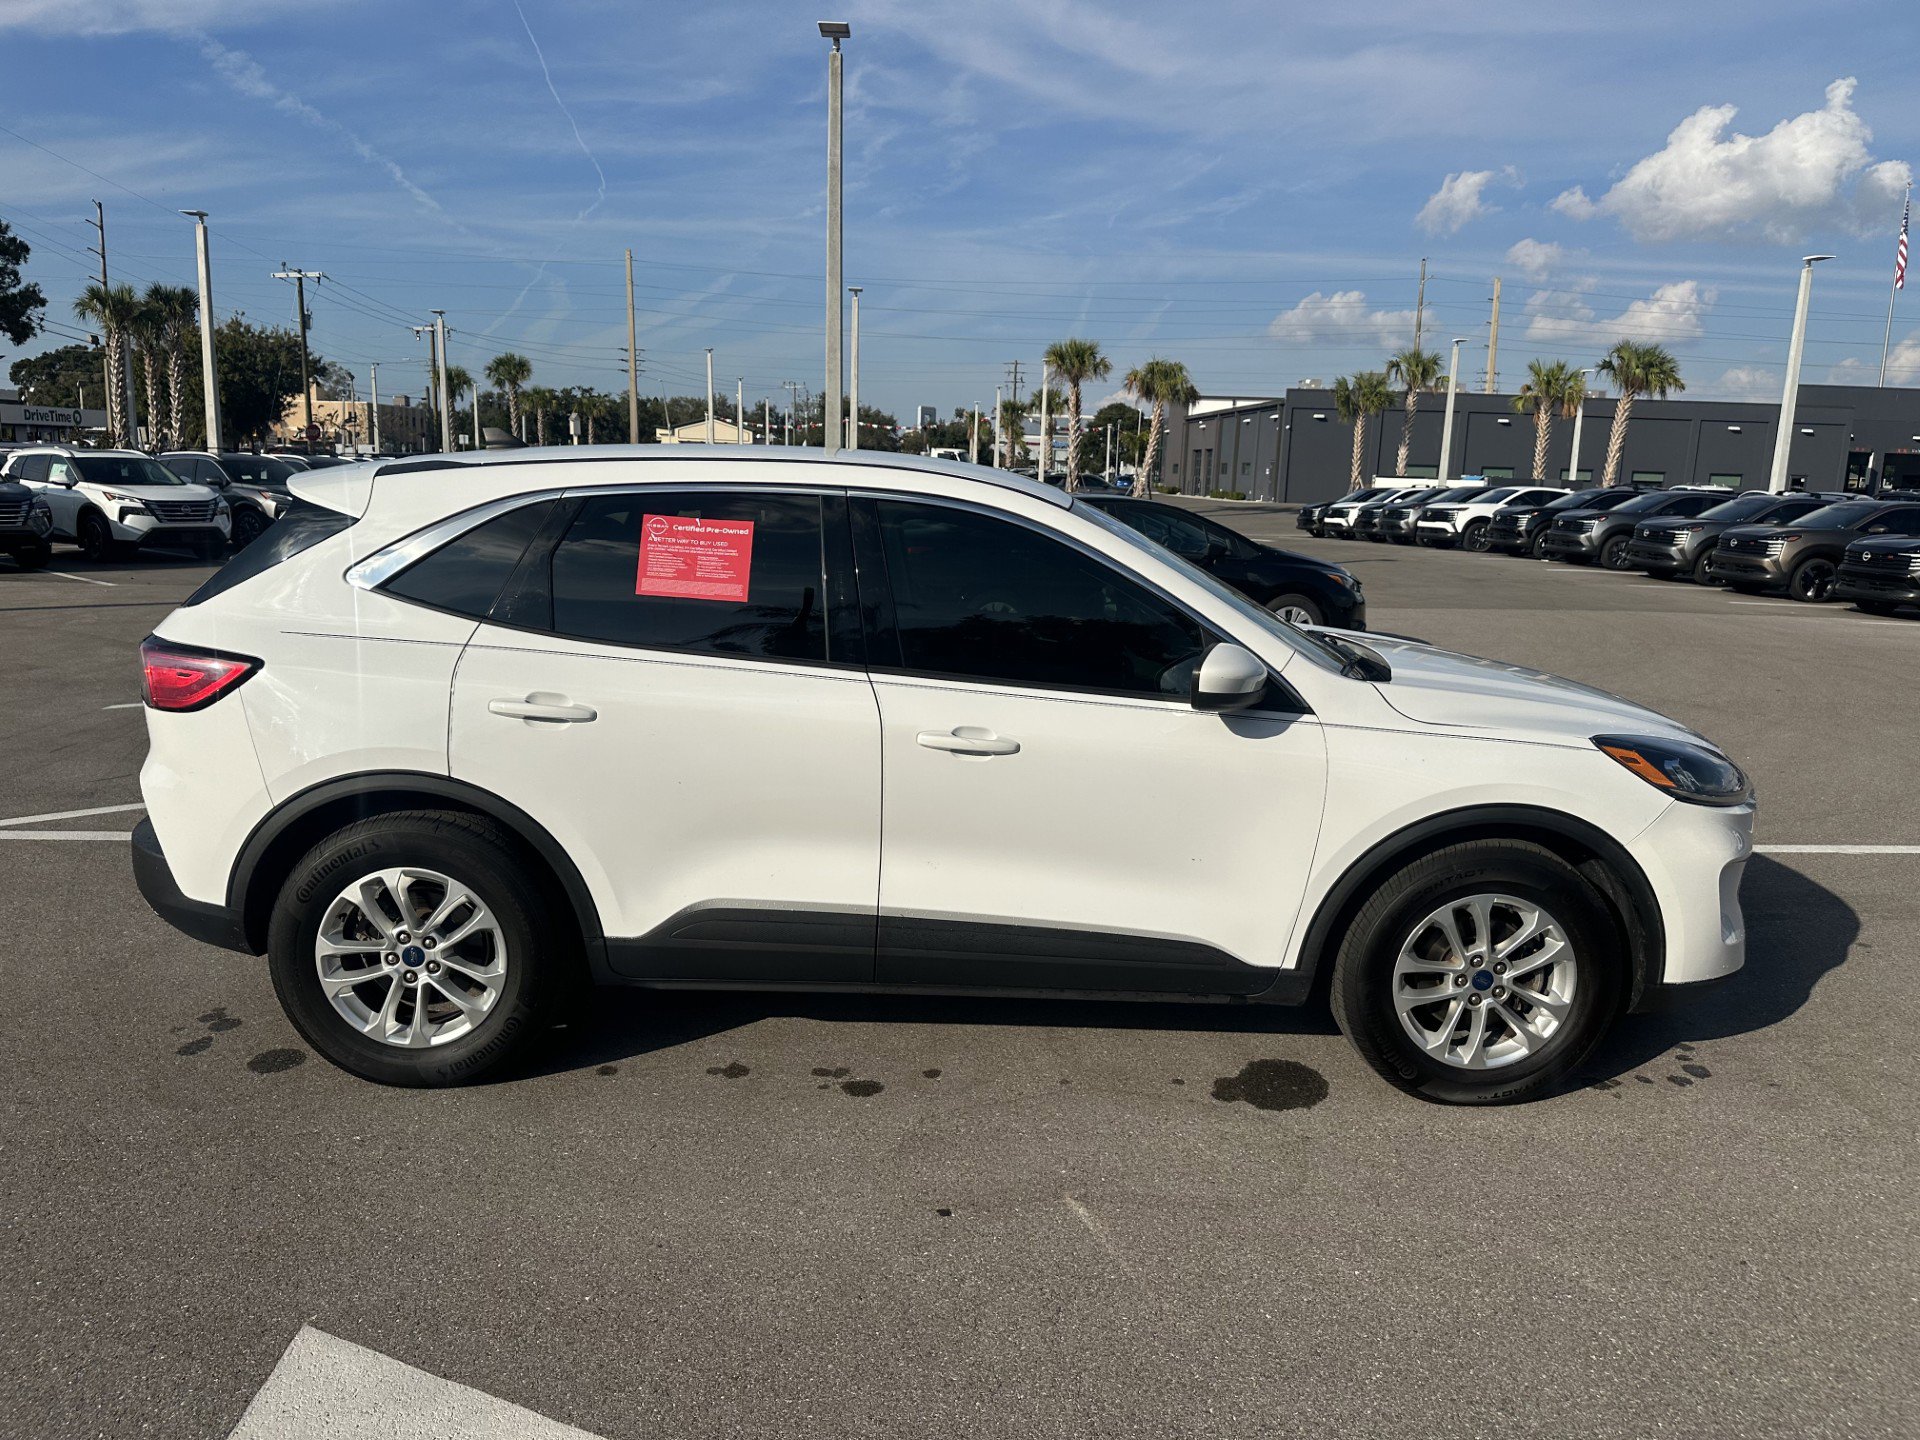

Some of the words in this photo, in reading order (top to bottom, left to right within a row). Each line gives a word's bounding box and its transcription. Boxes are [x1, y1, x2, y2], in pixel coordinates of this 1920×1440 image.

[24, 409, 71, 423] DriveTime
[673, 524, 705, 533] Certified
[706, 525, 749, 535] Pre-Owned
[298, 843, 368, 903] Continental
